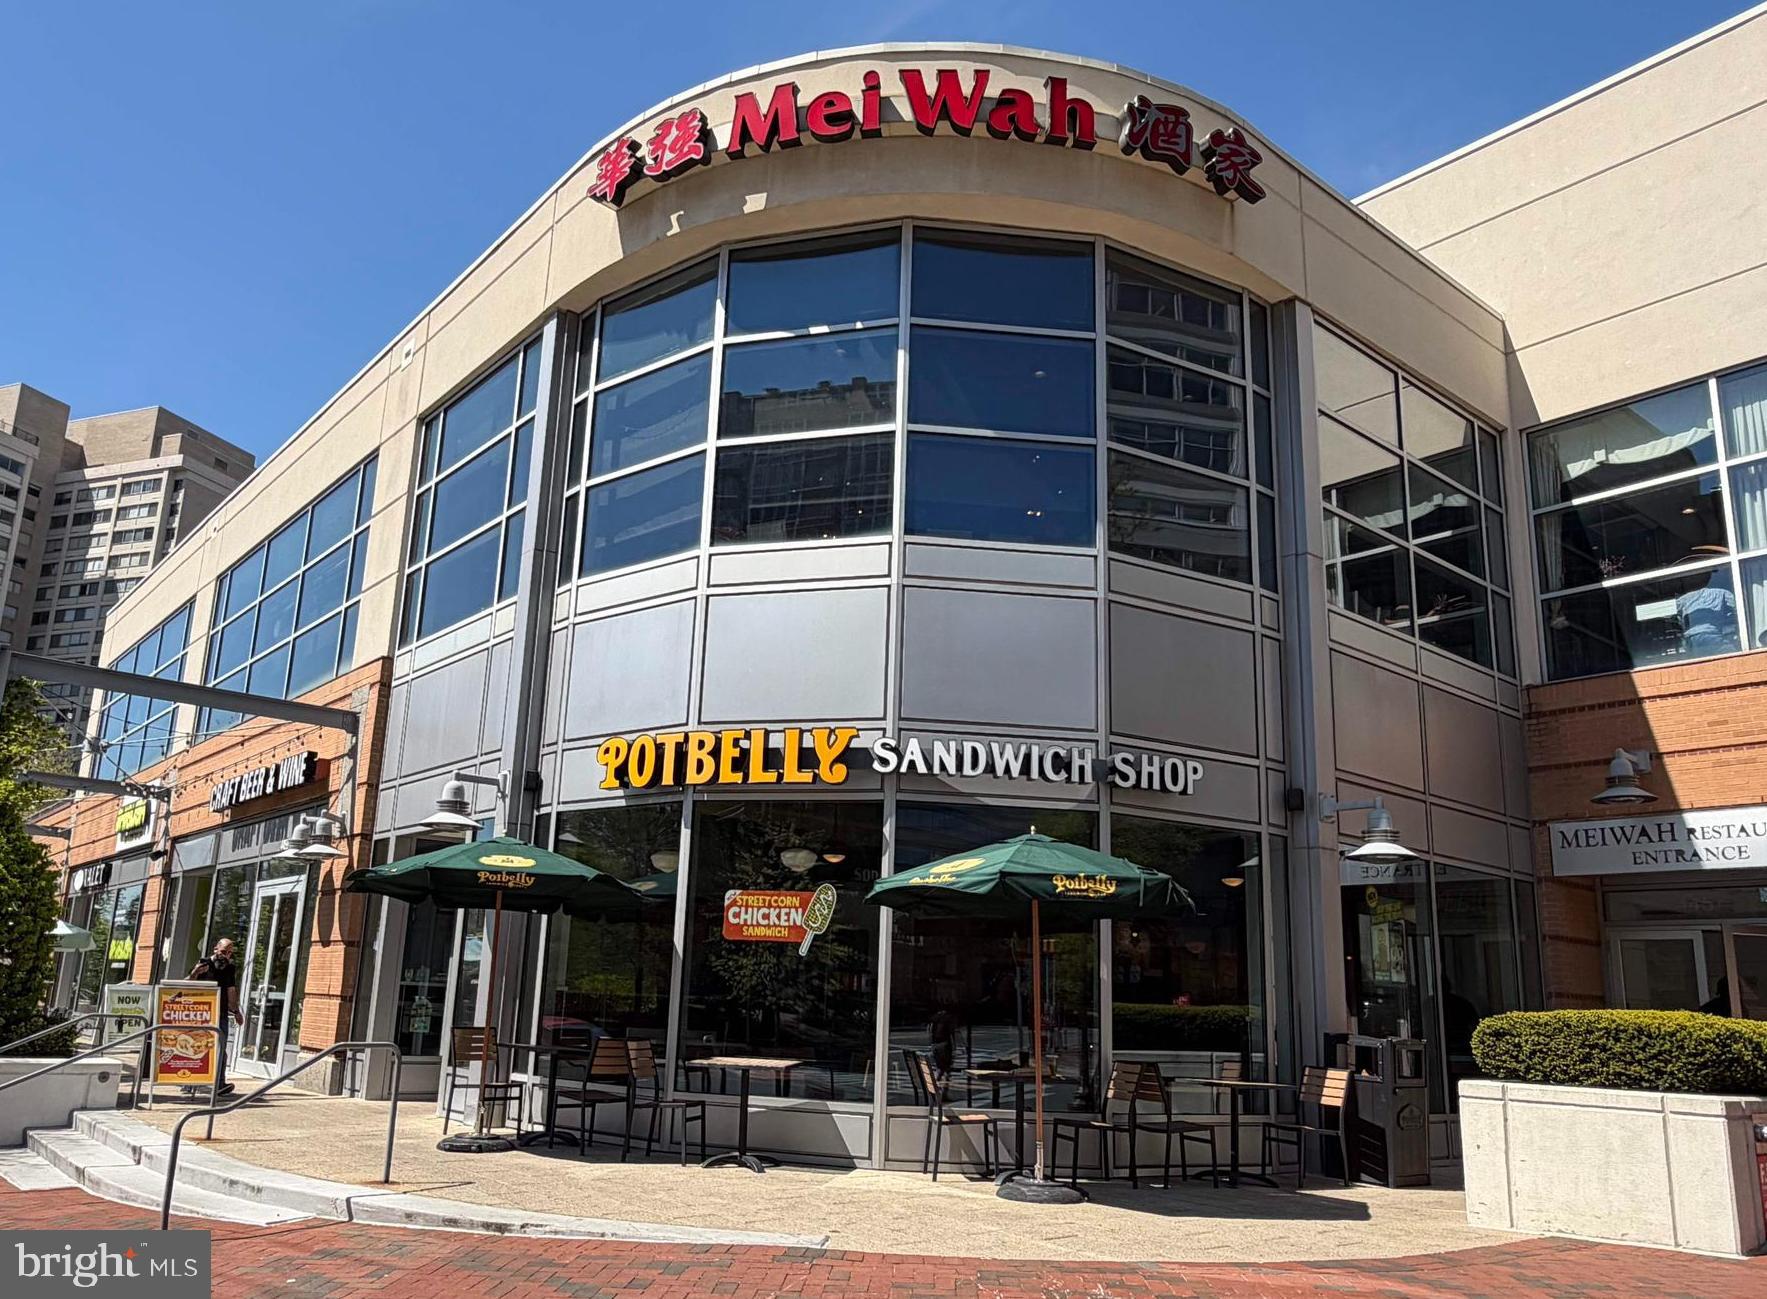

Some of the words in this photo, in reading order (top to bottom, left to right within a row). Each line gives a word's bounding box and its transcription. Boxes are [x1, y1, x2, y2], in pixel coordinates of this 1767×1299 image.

[596, 727, 860, 790] POTBELLY
[872, 737, 1094, 784] SANDWICH
[1113, 752, 1204, 796] SHOP
[210, 776, 242, 812] CRAFT
[239, 767, 267, 802] BEER
[266, 763, 277, 794] &
[277, 751, 308, 790] WINE
[1559, 822, 1679, 850] MEIWAH
[1632, 845, 1751, 866] ENTRANCE
[728, 907, 803, 927] CHICKEN
[742, 926, 789, 938] SANDWICH
[118, 995, 141, 1005] NOW
[163, 1010, 212, 1021] CHICKEN
